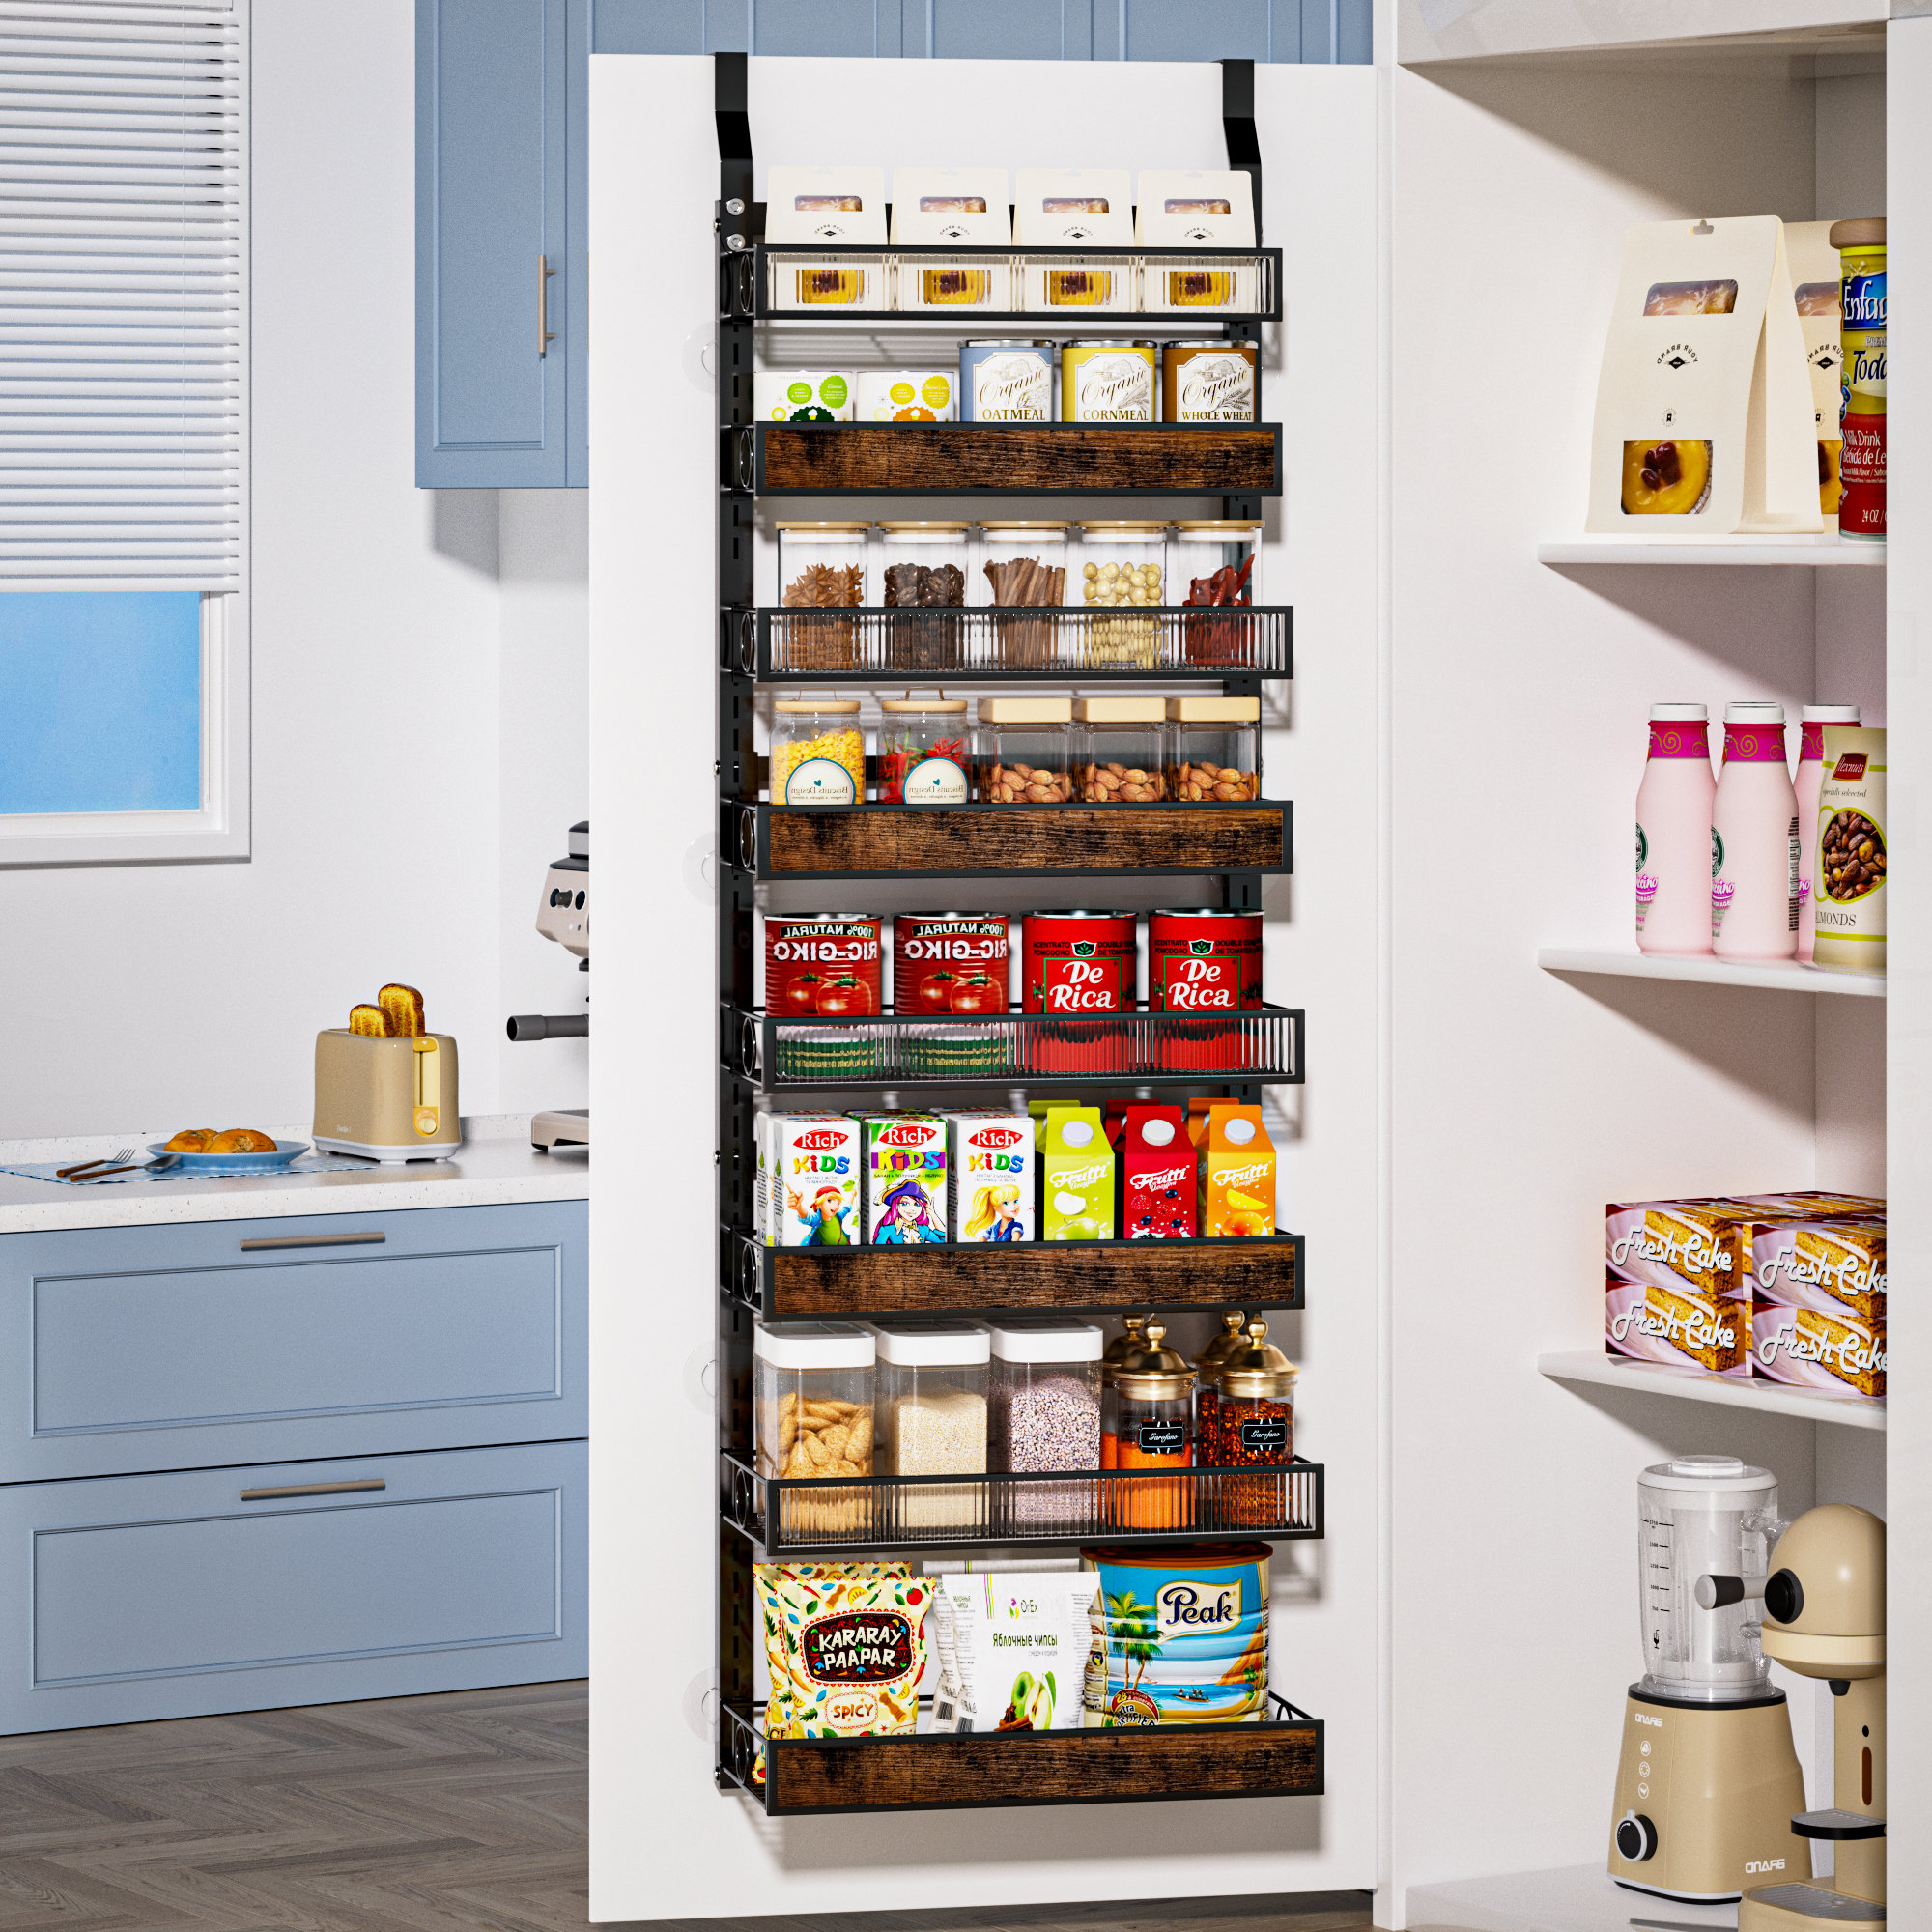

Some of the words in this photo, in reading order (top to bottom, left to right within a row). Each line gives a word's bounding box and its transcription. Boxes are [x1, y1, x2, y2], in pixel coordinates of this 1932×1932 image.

[980, 367, 1043, 406] Organic
[1082, 367, 1146, 406] Organic
[1182, 367, 1247, 406] Organic
[982, 409, 1045, 420] OATMEAL
[1083, 409, 1149, 420] CORNMEAL
[1181, 412, 1219, 421] WHOLE
[1222, 412, 1252, 421] WHEAT
[1858, 430, 1881, 447] Drink
[1863, 448, 1874, 465] de
[1063, 960, 1103, 984] De
[1180, 958, 1221, 982] De
[1049, 984, 1116, 1012] Rica
[1168, 982, 1235, 1009] Rica
[801, 1131, 840, 1148] Rich
[889, 1127, 927, 1144] Rich
[977, 1130, 1014, 1146] Rich
[1049, 1164, 1108, 1187] Frutti
[1130, 1166, 1188, 1190] Frutti
[1212, 1162, 1270, 1187] Frutti
[1611, 1225, 1678, 1266] Fresh
[1683, 1234, 1732, 1274] Cake
[1758, 1245, 1832, 1289] Fresh
[1837, 1255, 1887, 1295] Cake
[1611, 1300, 1680, 1342] Fresh
[1683, 1309, 1735, 1350] Cake
[1758, 1323, 1833, 1366] Fresh
[1838, 1332, 1887, 1375] Cake
[1163, 1586, 1233, 1624] Peak
[818, 1626, 902, 1652] KARARAY
[993, 1633, 1033, 1647] Яблочные
[1034, 1634, 1058, 1646] чипсы
[823, 1648, 896, 1670] PAAPAR
[1115, 1691, 1128, 1704] 28
[833, 1703, 874, 1719] SPICY
